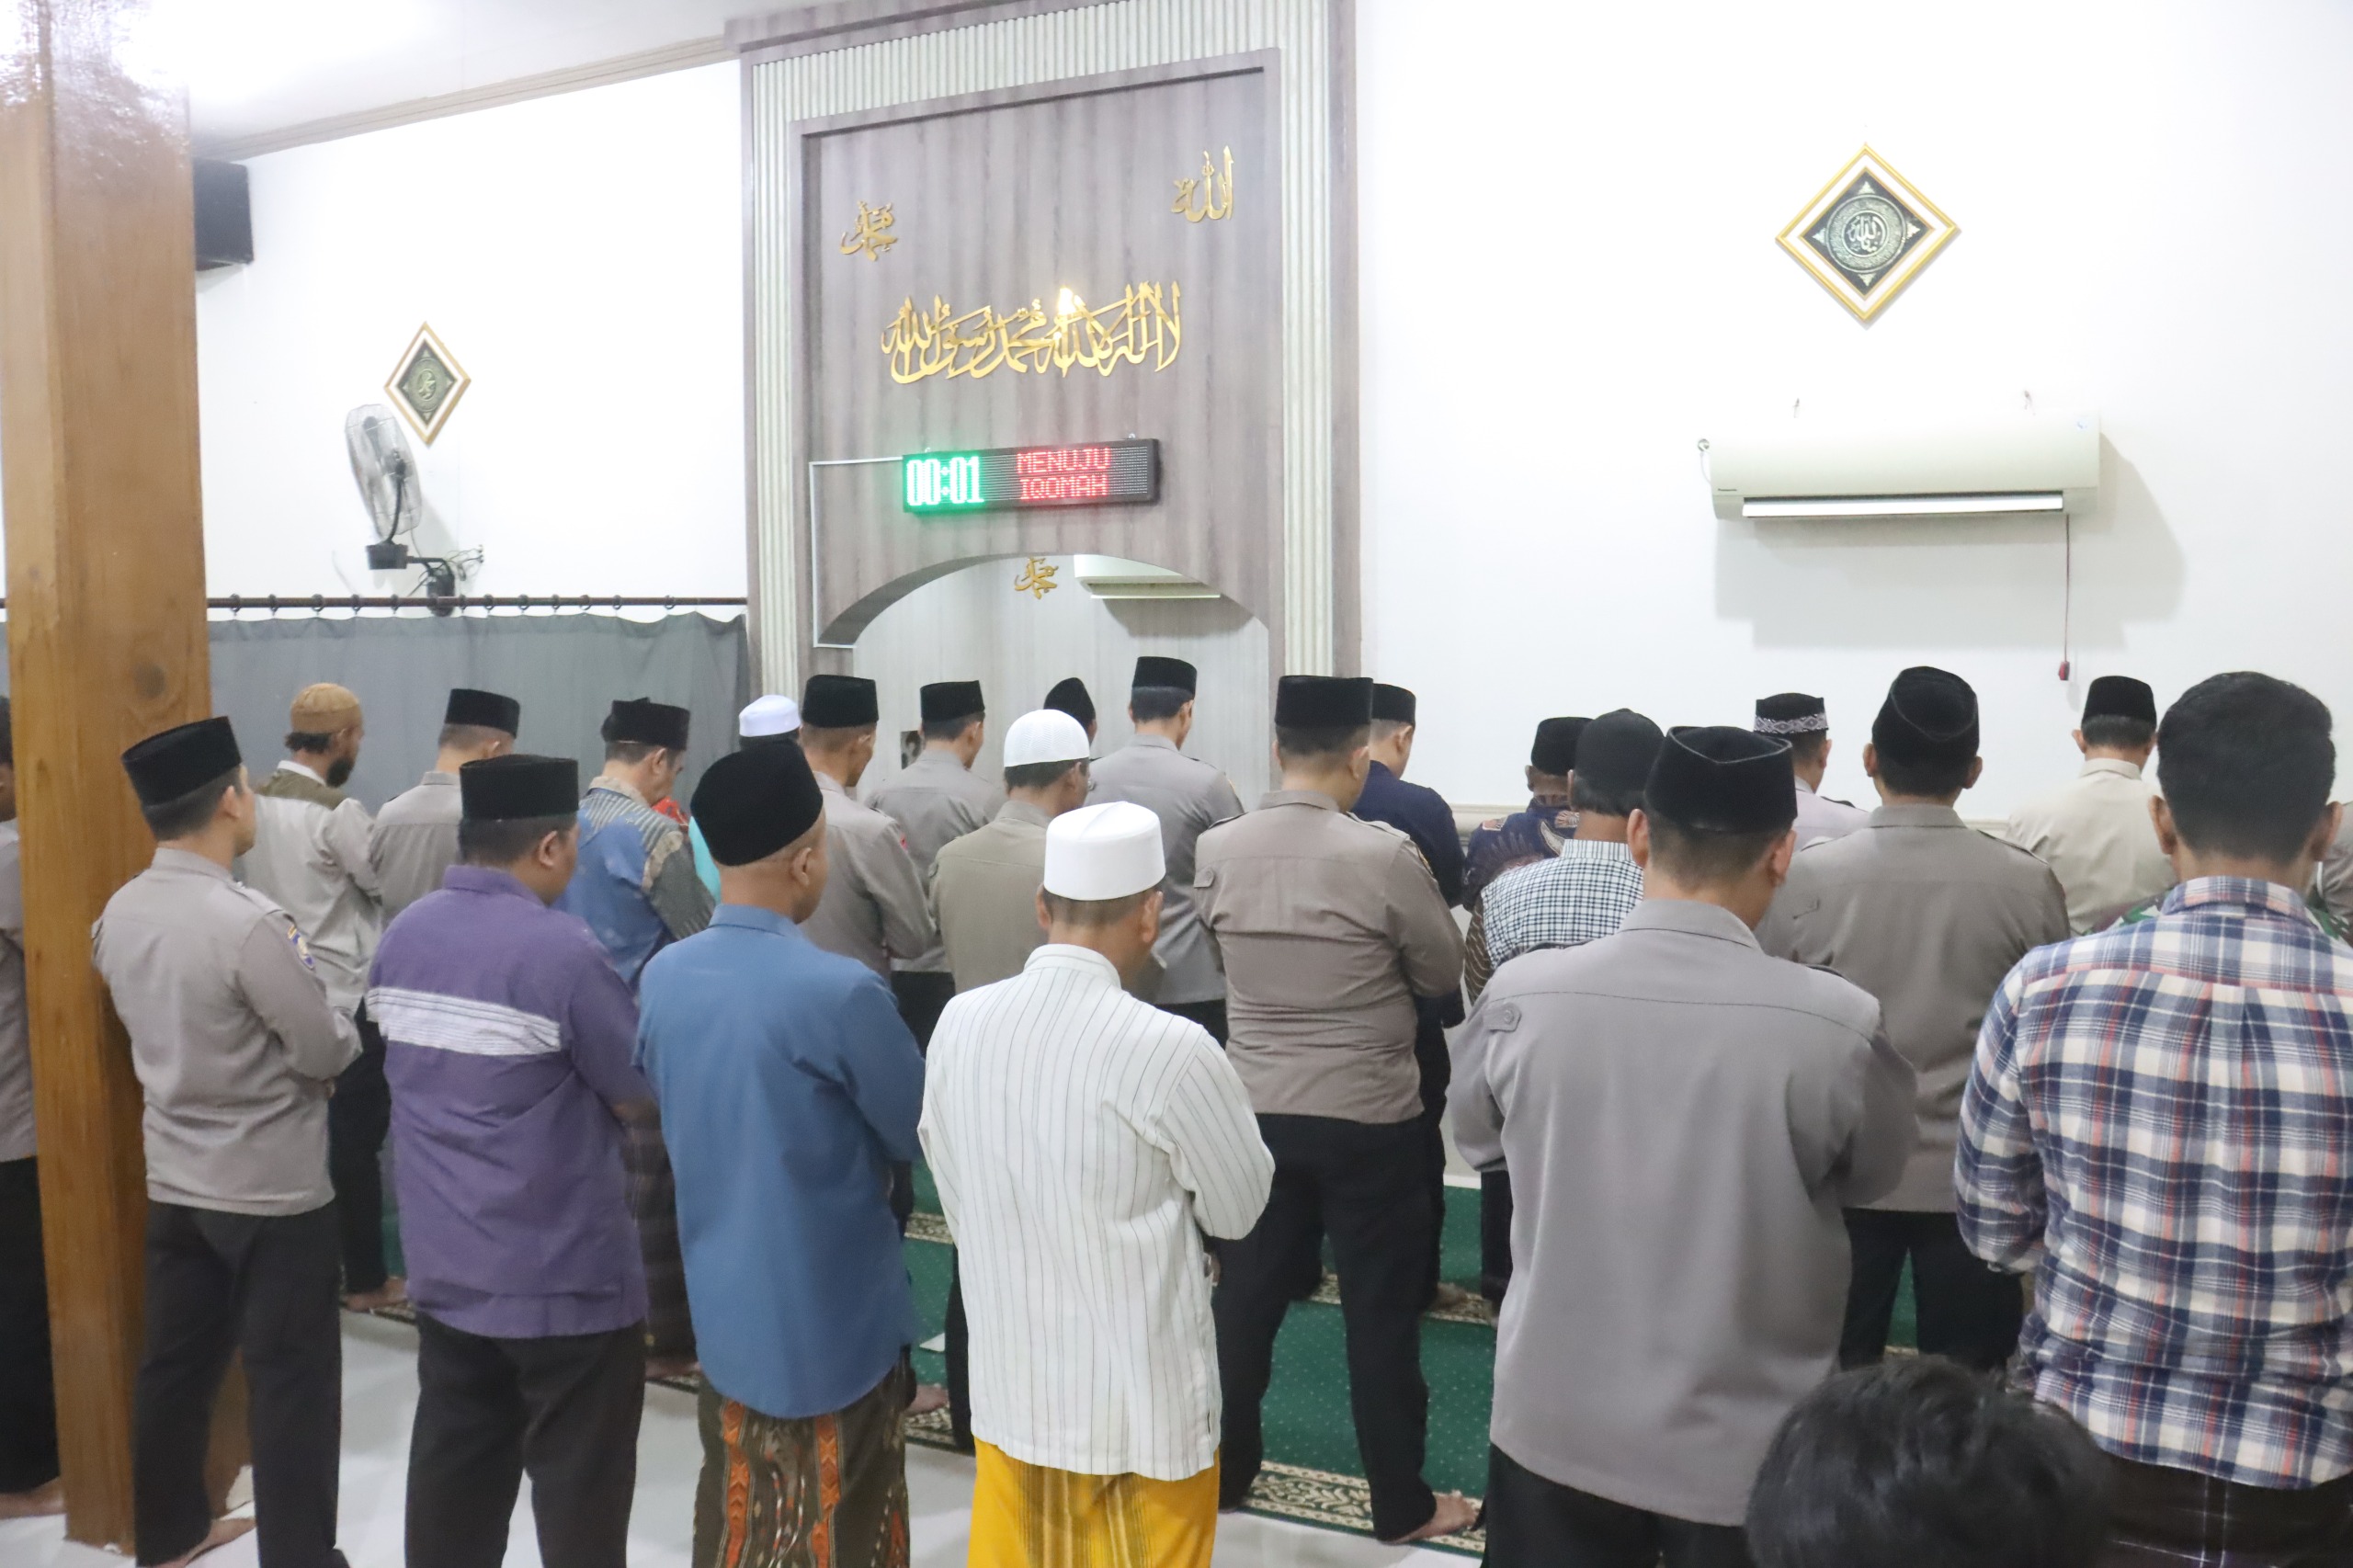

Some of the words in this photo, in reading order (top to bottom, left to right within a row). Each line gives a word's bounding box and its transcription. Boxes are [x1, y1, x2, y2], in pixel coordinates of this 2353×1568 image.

[1171, 145, 1233, 222] الله
[1017, 448, 1108, 473] MENUJU
[906, 456, 984, 506] 00:01
[1019, 474, 1108, 499] IQOMAH
